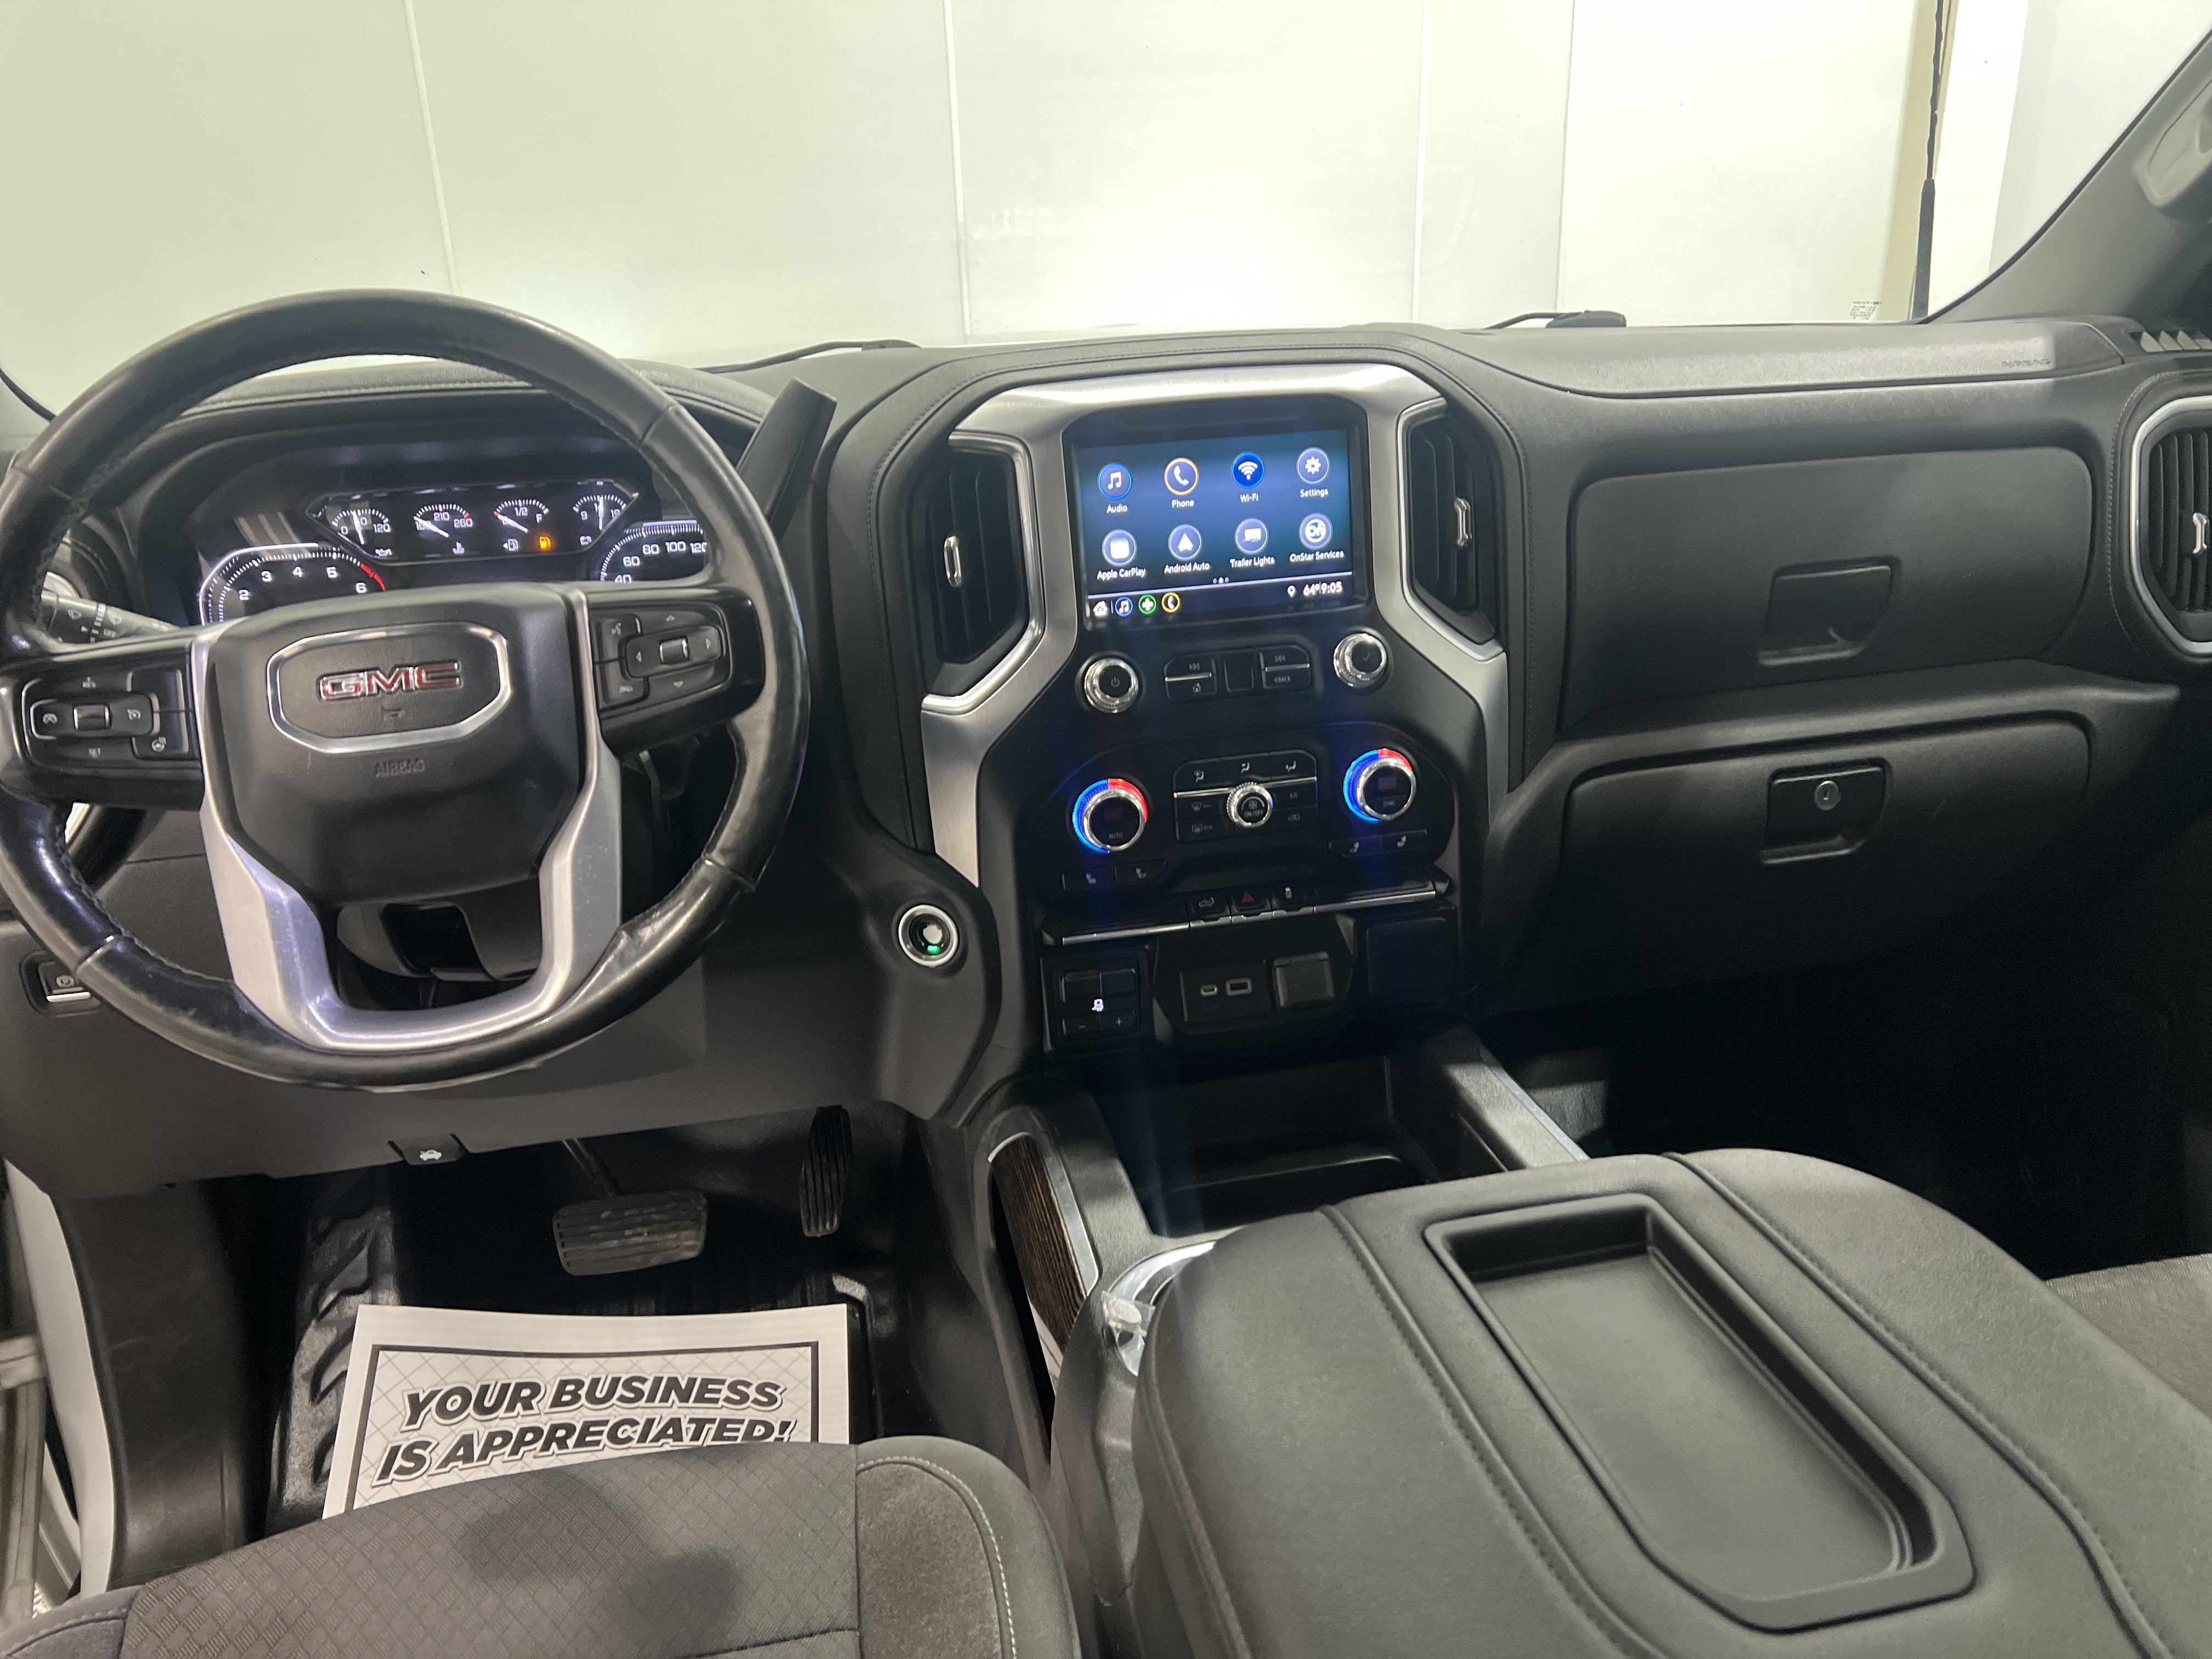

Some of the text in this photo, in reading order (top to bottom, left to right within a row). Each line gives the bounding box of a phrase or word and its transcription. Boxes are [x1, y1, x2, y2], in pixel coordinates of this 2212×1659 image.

[1240, 493, 1259, 503] Wi-Fi
[1300, 488, 1329, 498] Settings
[1107, 503, 1127, 514] Audio
[1171, 499, 1194, 508] Phone
[433, 511, 450, 522] 210
[515, 506, 528, 516] 1/2
[454, 518, 473, 528] 260
[536, 513, 542, 523] F
[340, 525, 348, 535] 0
[373, 522, 391, 533] 120
[642, 544, 659, 555] 80
[665, 541, 686, 553] 100
[623, 555, 640, 567] 60
[1290, 550, 1344, 562] OnStar Services
[1229, 556, 1275, 568] Trailer Lights
[292, 566, 303, 578] 4
[326, 566, 337, 578] 5
[1164, 562, 1210, 574] Android Auto
[261, 571, 272, 582] 3
[614, 574, 632, 584] 40
[1097, 567, 1146, 581] Apple CarPlay
[356, 582, 367, 594] 6
[1321, 580, 1343, 594] 9:05
[239, 589, 249, 600] 2
[319, 662, 461, 700] GMC
[404, 1375, 782, 1430] YOUR BUSINESS
[376, 1417, 792, 1481] IS APPRECIATED!
